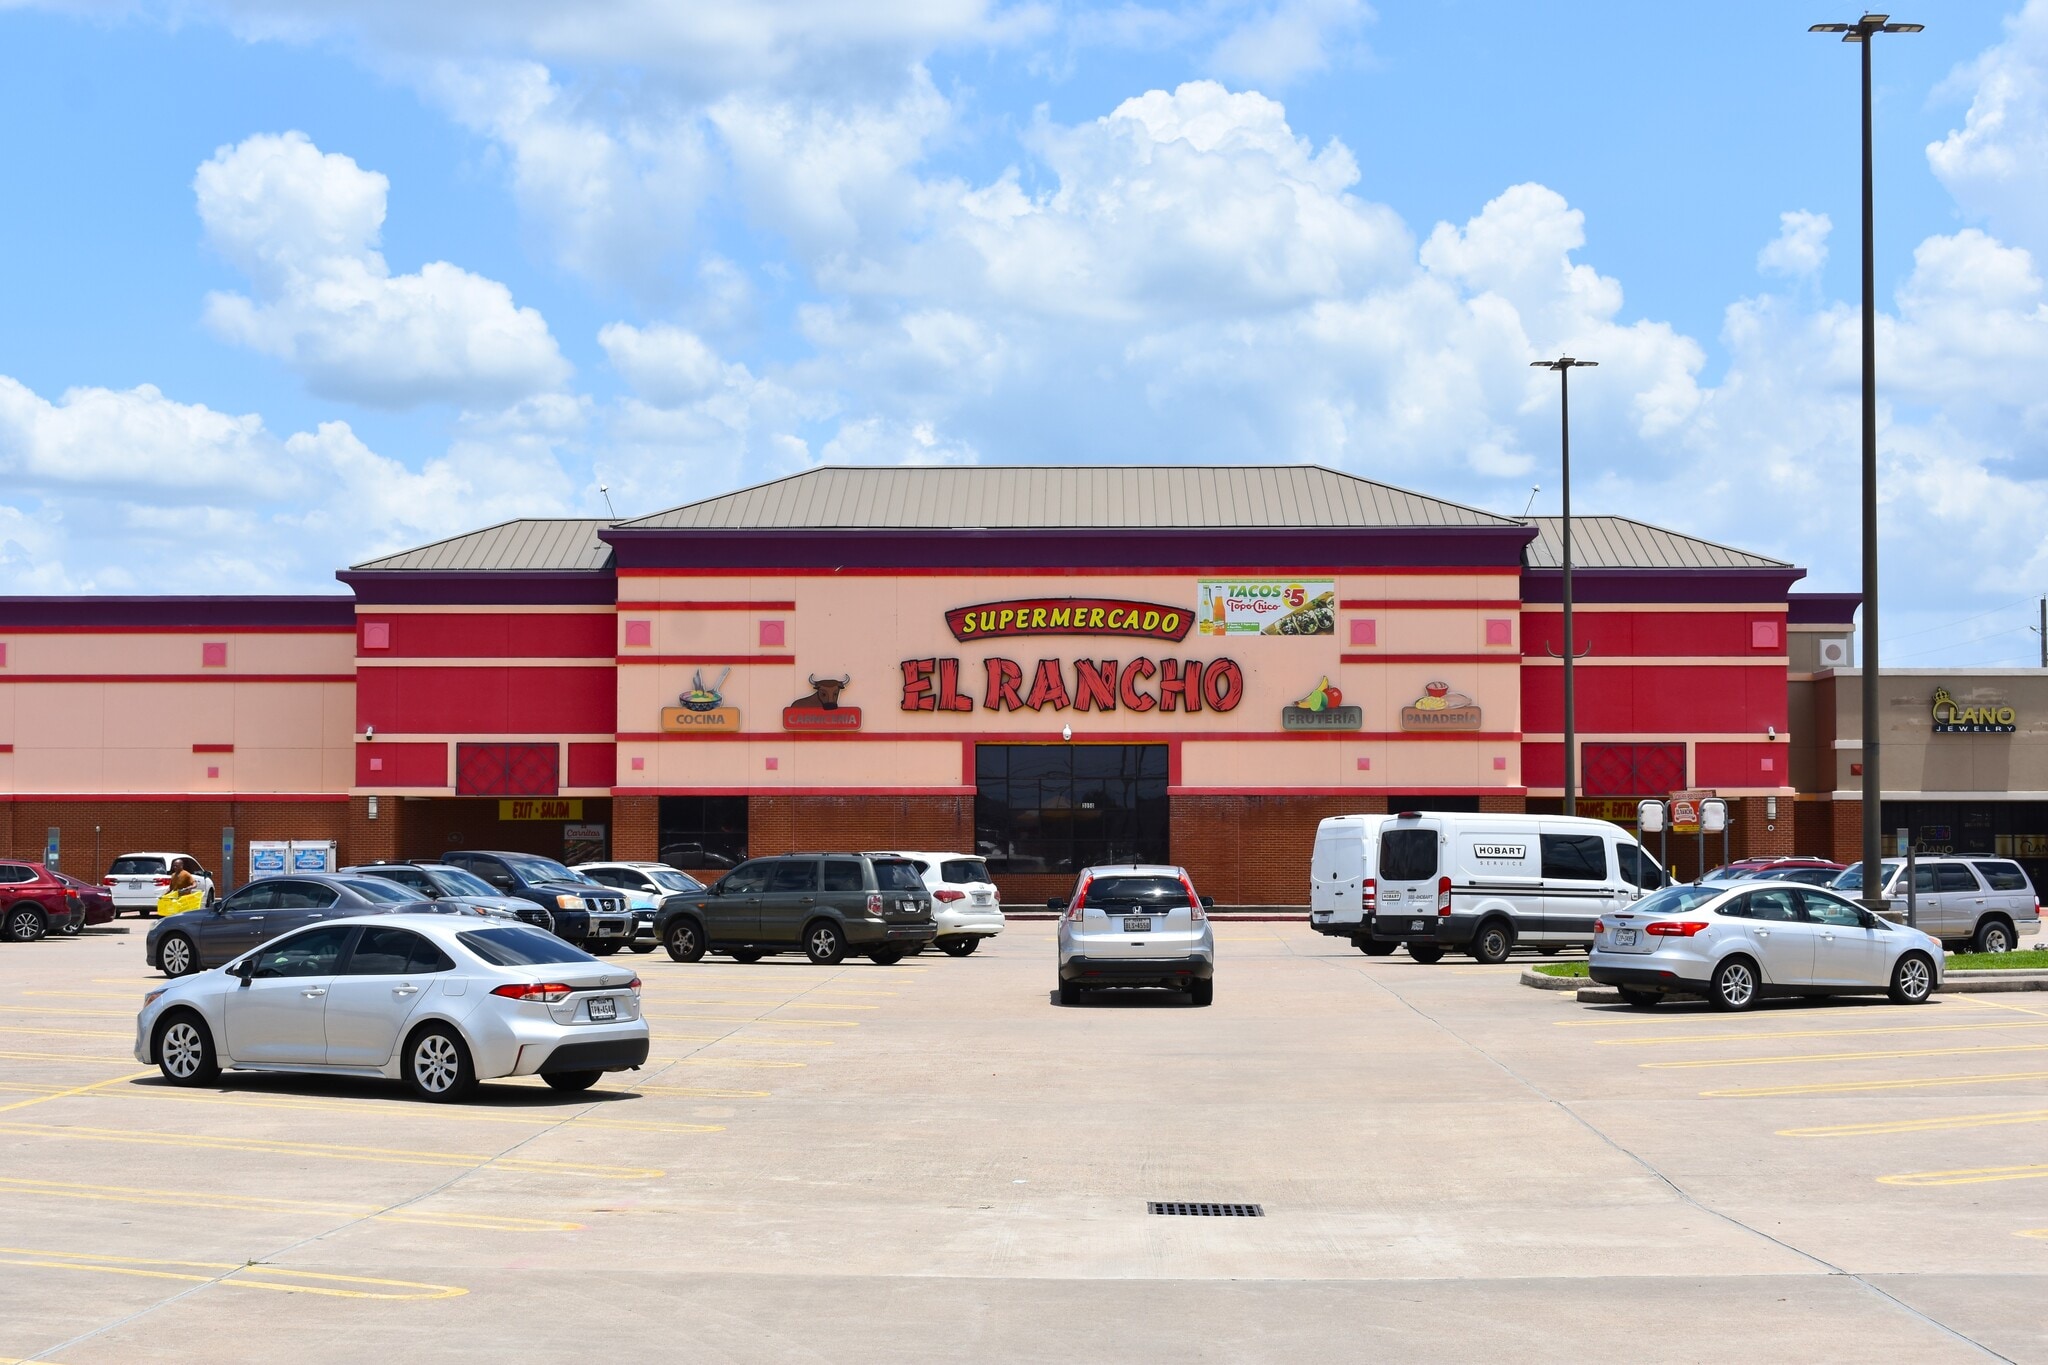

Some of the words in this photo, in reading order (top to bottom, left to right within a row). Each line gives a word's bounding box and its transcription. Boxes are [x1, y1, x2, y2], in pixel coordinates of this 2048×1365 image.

[1228, 585, 1282, 598] TACOS
[1284, 588, 1305, 607] $5
[962, 607, 1180, 633] SUPERMERCADO
[900, 657, 974, 712] EL
[983, 656, 1244, 713] RANCHO
[676, 714, 725, 725] COCINA
[1287, 711, 1358, 724] FRUTERÍA
[512, 801, 534, 819] EXIT
[540, 801, 570, 819] SALIDA
[1479, 846, 1522, 855] HOBART
